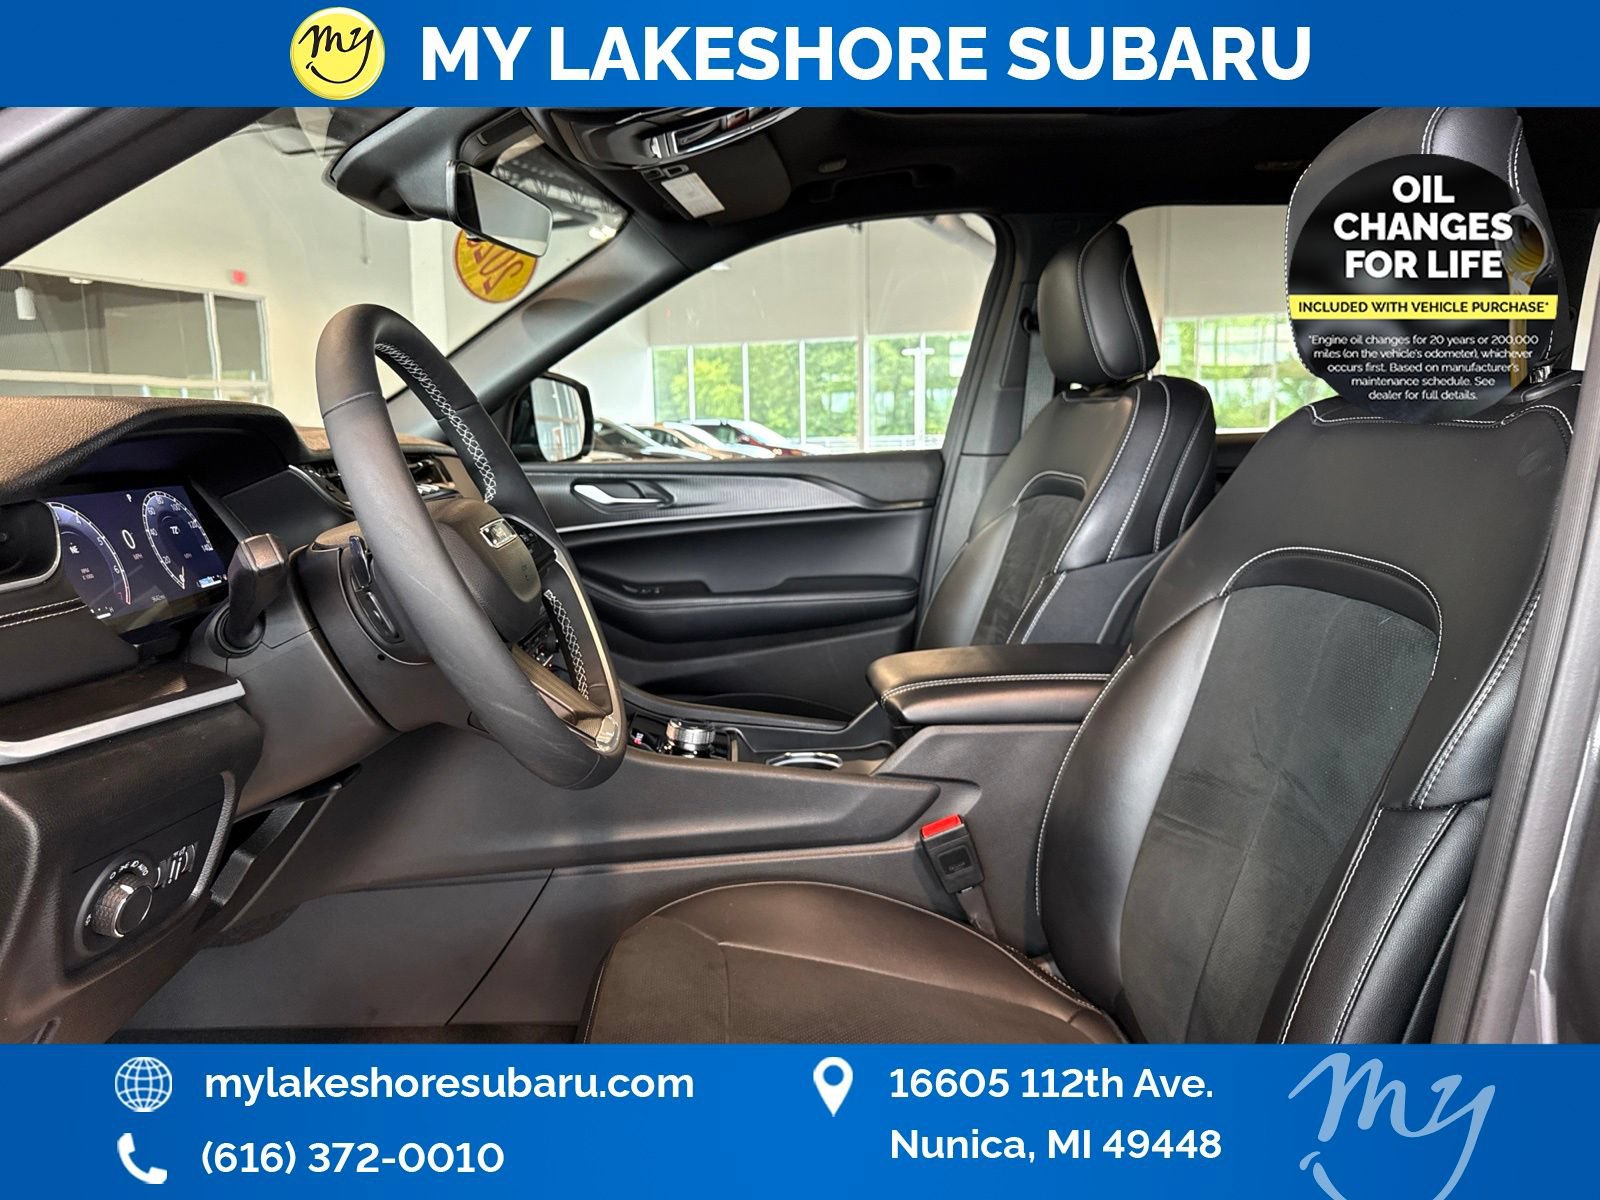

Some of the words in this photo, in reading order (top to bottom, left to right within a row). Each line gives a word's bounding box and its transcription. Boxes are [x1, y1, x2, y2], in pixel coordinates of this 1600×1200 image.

[96, 536, 104, 547] 5
[121, 529, 136, 549] 0
[113, 565, 121, 575] 6
